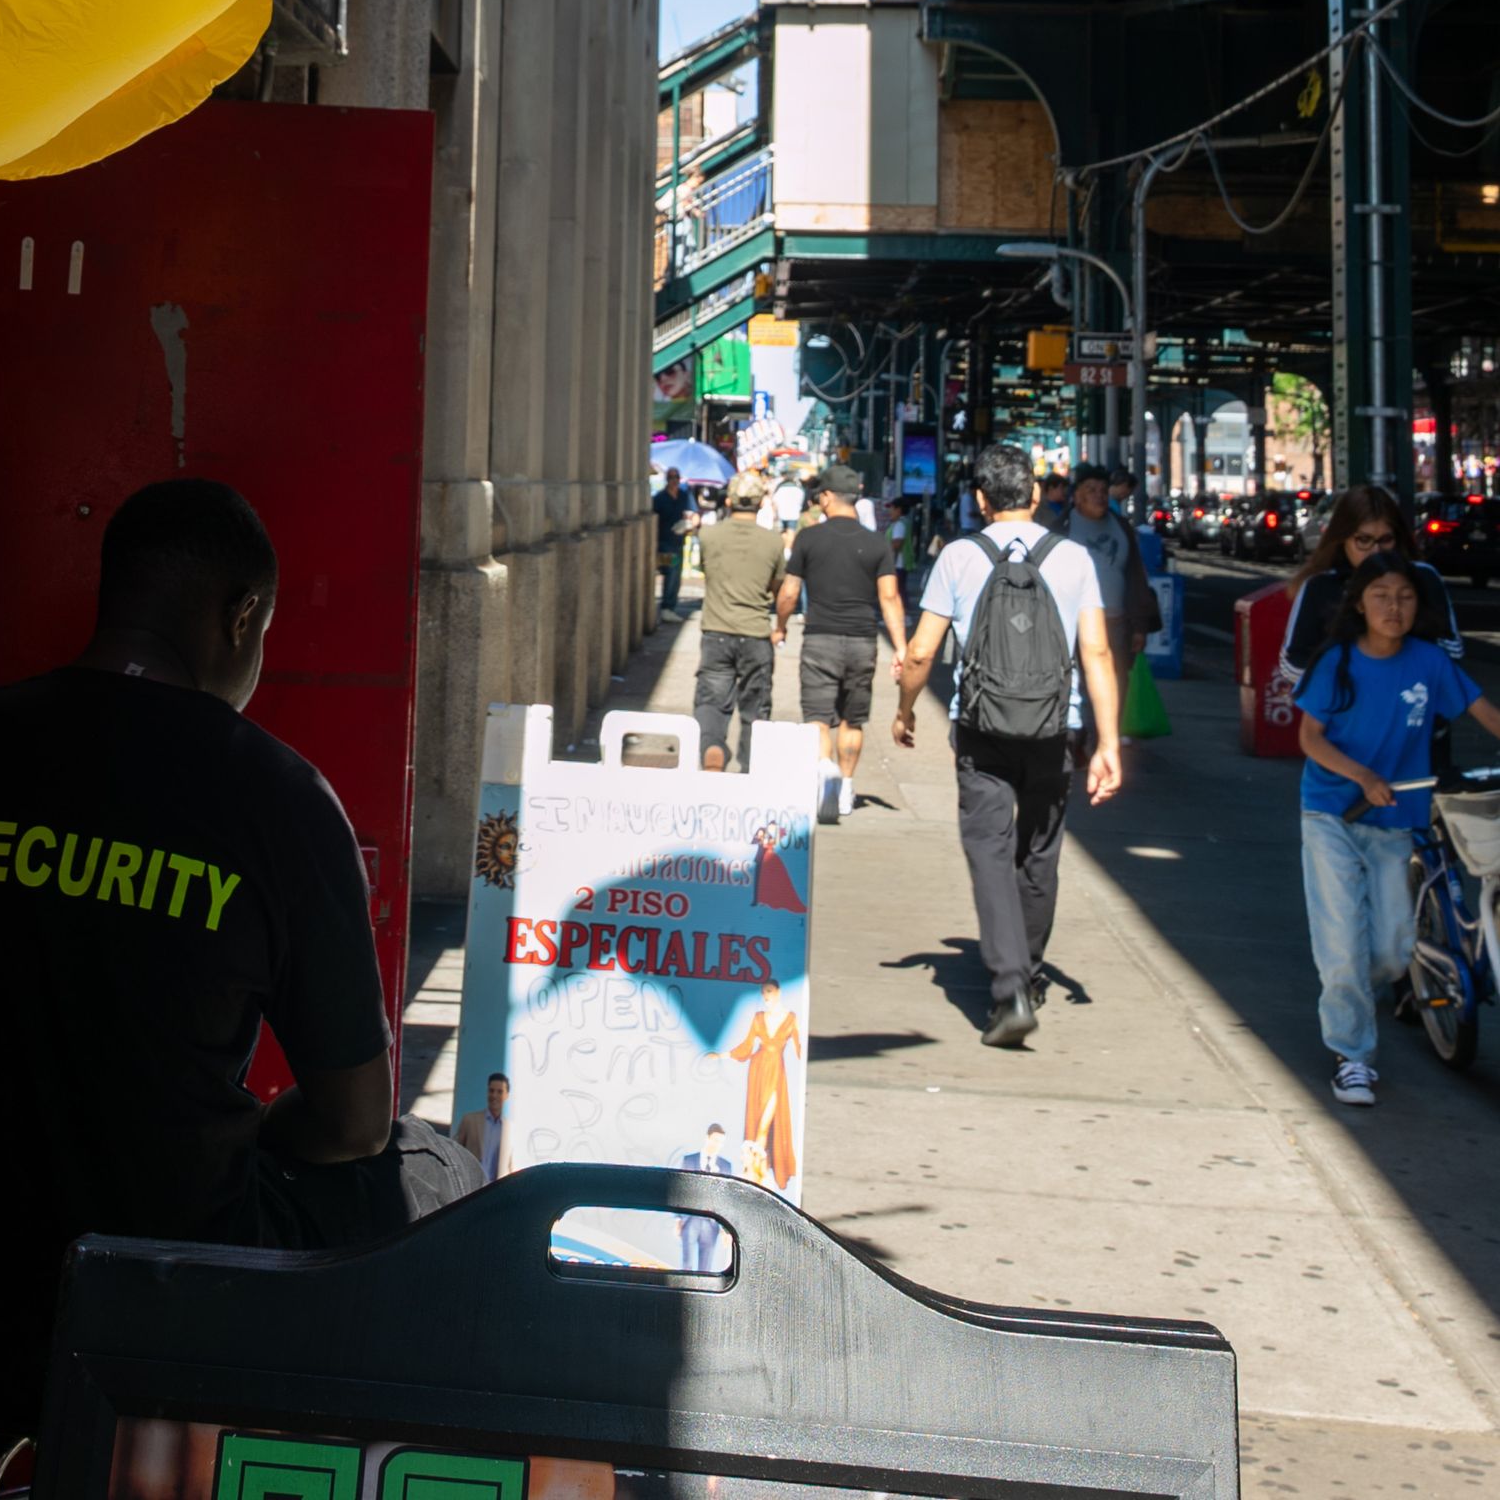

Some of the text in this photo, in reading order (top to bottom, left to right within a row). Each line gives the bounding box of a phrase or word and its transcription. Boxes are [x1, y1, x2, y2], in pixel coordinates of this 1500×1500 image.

[1080, 365, 1097, 384] 82
[574, 886, 690, 919] 2 PISO
[503, 916, 772, 985] ESPECIALES
[527, 972, 684, 1032] OPEN
